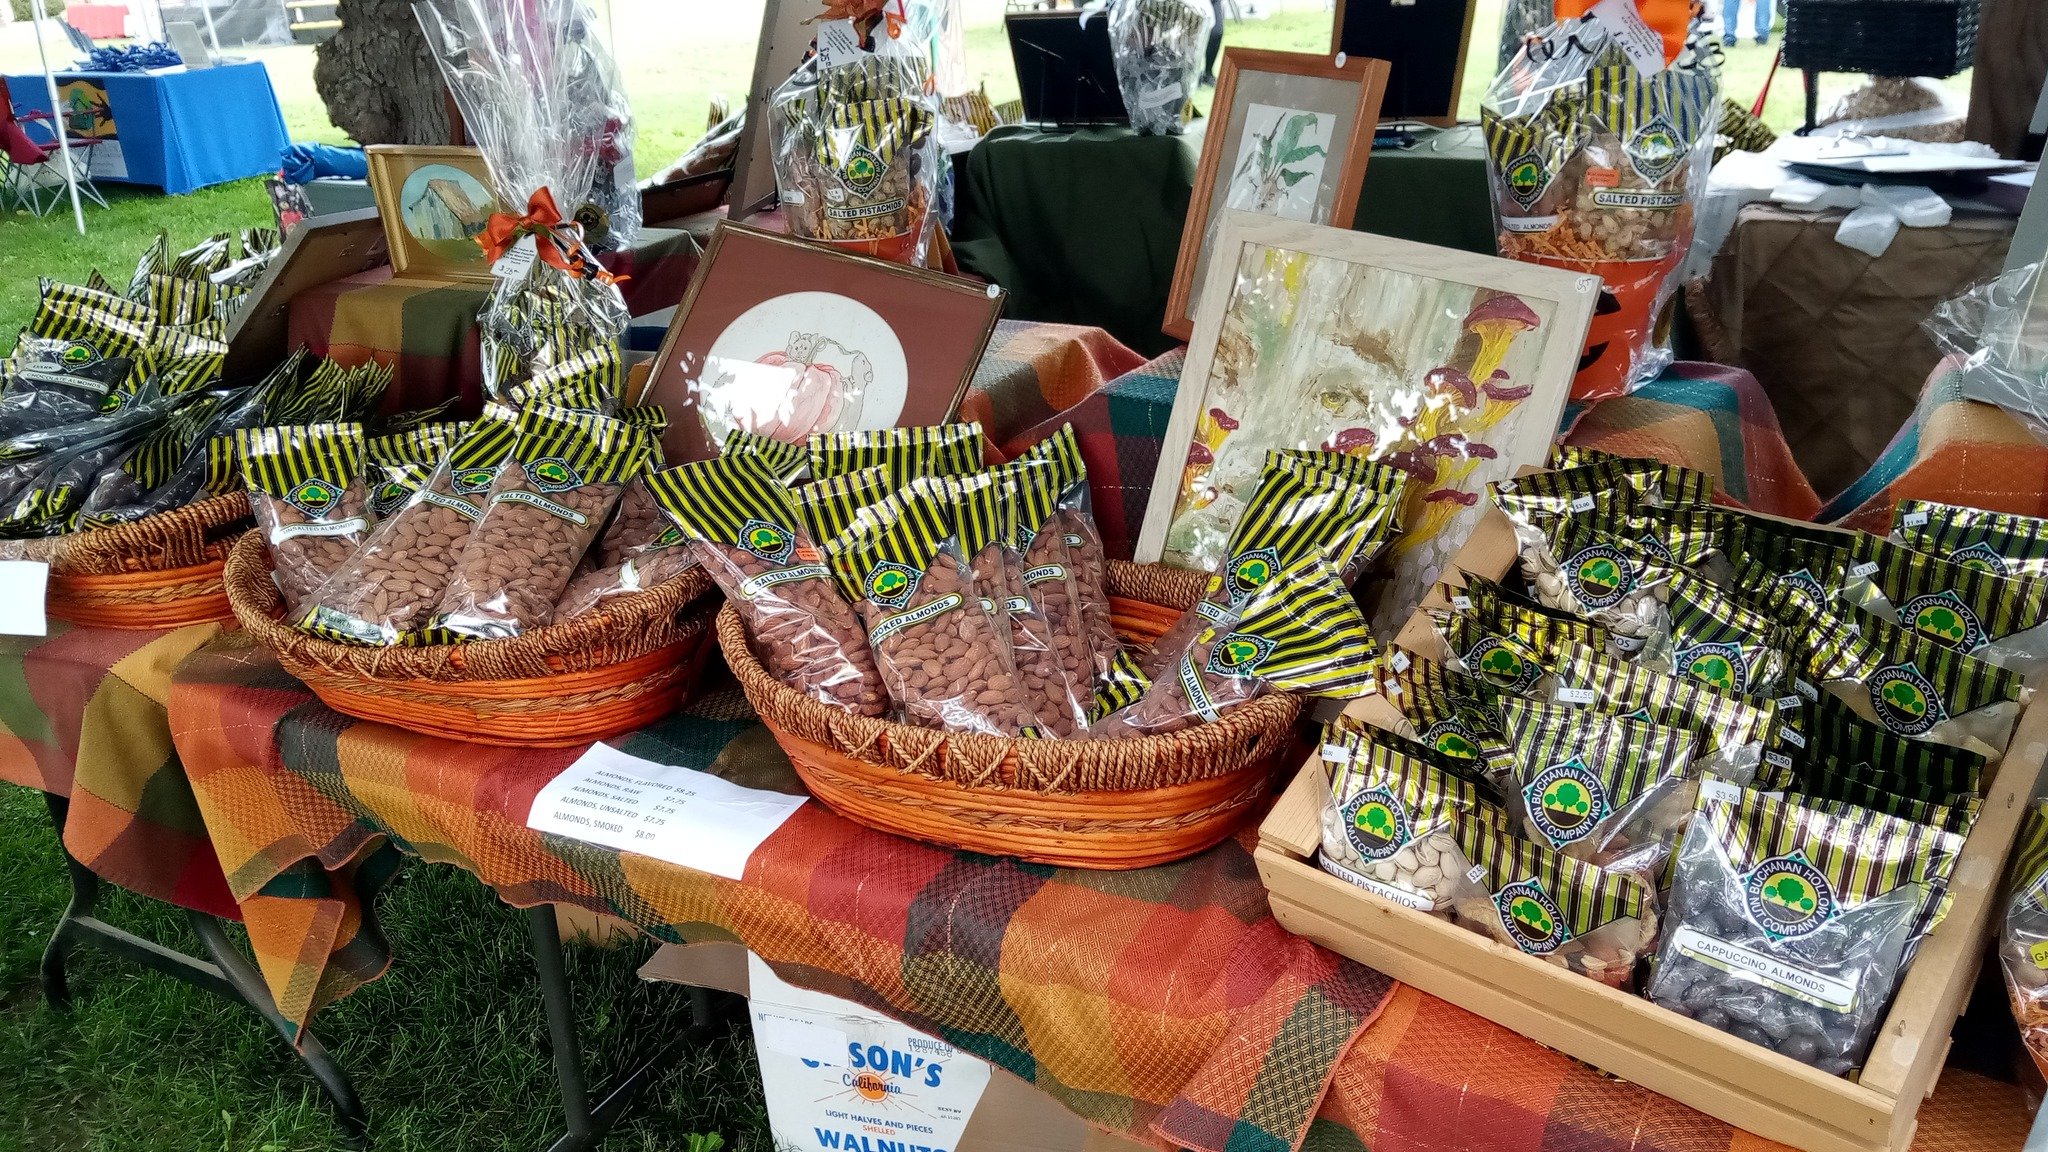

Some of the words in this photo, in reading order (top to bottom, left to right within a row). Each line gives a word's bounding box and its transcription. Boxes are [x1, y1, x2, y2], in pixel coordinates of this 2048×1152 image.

[829, 208, 857, 218] SALTED
[860, 201, 902, 215] PISTACHIOS
[1599, 194, 1639, 205] SALTED
[26, 372, 67, 382] CHOCOLATE
[68, 378, 100, 388] ALMONDS
[500, 491, 532, 501] SALTED
[532, 498, 575, 518] ALMONDS
[283, 525, 320, 535] UNSALTED
[320, 521, 355, 532] ALMONDS
[753, 549, 769, 558] NUT
[1231, 553, 1269, 574] BUCHANAN
[1268, 555, 1278, 576] HOLL
[1953, 551, 1984, 564] HANAN
[754, 571, 787, 588] SALTED
[866, 566, 888, 597] BUCHANAN
[888, 565, 915, 580] HOLLOW
[1023, 568, 1055, 582] MONDS
[1569, 549, 1613, 578] BUCHANAN
[1613, 555, 1631, 592] HOLLOW
[1857, 564, 1877, 575] $2.10
[874, 596, 888, 604] NUT
[889, 580, 915, 604] COMPANY
[1228, 580, 1236, 595] NUT
[1569, 578, 1583, 597] NUT
[1582, 591, 1621, 606] COMPANY
[1807, 584, 1823, 605] HOLL
[905, 600, 950, 622] ALMONDS
[1905, 598, 1953, 624] BUCHANAN
[1955, 605, 1977, 646] HOLLOW
[1211, 641, 1224, 660] NUT
[1226, 636, 1266, 654] BUCHANAN
[1470, 638, 1500, 668] BUCHANA
[1211, 658, 1240, 674] COMPANY
[1681, 646, 1734, 669] BUCHANAN
[1731, 657, 1744, 692] HOLLO
[1186, 676, 1211, 716] ALMONDS
[1570, 690, 1593, 699] $2.50
[1781, 697, 1798, 707] $3.50
[1872, 670, 1914, 696] BUCHANAN
[1914, 679, 1937, 721] HOLLOW
[1873, 697, 1888, 716] NUT
[1886, 716, 1930, 733] COMPANY
[1428, 724, 1460, 749] BUCHANAN
[1781, 729, 1802, 744] $3.50
[1767, 752, 1790, 765] $3.50
[583, 777, 620, 791] ALMONDS,
[622, 787, 643, 795] RAW
[664, 795, 687, 805] $7.75
[596, 770, 633, 784] ALMONDS,
[634, 780, 673, 790] FLAVORED
[674, 787, 697, 796] $8.25
[1532, 768, 1578, 805] BUCHANAN
[1579, 773, 1601, 819] HOLLOW
[560, 796, 598, 810] ALMONDS,
[599, 804, 638, 819] UNSALTED
[643, 815, 666, 826] $7.75
[571, 785, 609, 799] ALMONDS,
[610, 794, 639, 805] SALTED
[653, 804, 676, 814] $7.75
[553, 811, 592, 828] ALMONDS,
[593, 819, 623, 833] SMOKED
[635, 829, 656, 840] $8.00
[1347, 792, 1386, 823] BUCHANAN
[1387, 801, 1404, 844] HOLLOW
[1533, 807, 1550, 827] NUT
[1546, 818, 1594, 839] COMPANY
[1347, 824, 1361, 845] NUT
[1358, 842, 1397, 859] COMPANY
[1321, 859, 1354, 884] SALTED
[1356, 878, 1418, 910] PISTACHIOS
[1470, 866, 1486, 880] $2.50
[1749, 861, 1802, 895] BUCHANAN
[1803, 869, 1829, 919] HOLLOW
[1501, 886, 1539, 913] BUCHANAN
[1539, 896, 1563, 940] HOLLOW
[1749, 897, 1767, 918] NUT
[1762, 916, 1819, 935] COMPANY
[1503, 914, 1518, 935] NUT
[1516, 934, 1557, 951] COMPANY
[1697, 940, 1767, 971] CAPPUCCINO
[1771, 967, 1826, 993] ALMONDS
[908, 1037, 942, 1050] PRODUCE
[801, 1042, 942, 1087] SON'S
[842, 1073, 903, 1096] California
[825, 1109, 848, 1120] LIGHT
[851, 1113, 882, 1125] HALVES
[885, 1118, 904, 1128] AND
[906, 1123, 933, 1134] PIECES
[862, 1124, 896, 1135] SHELLED
